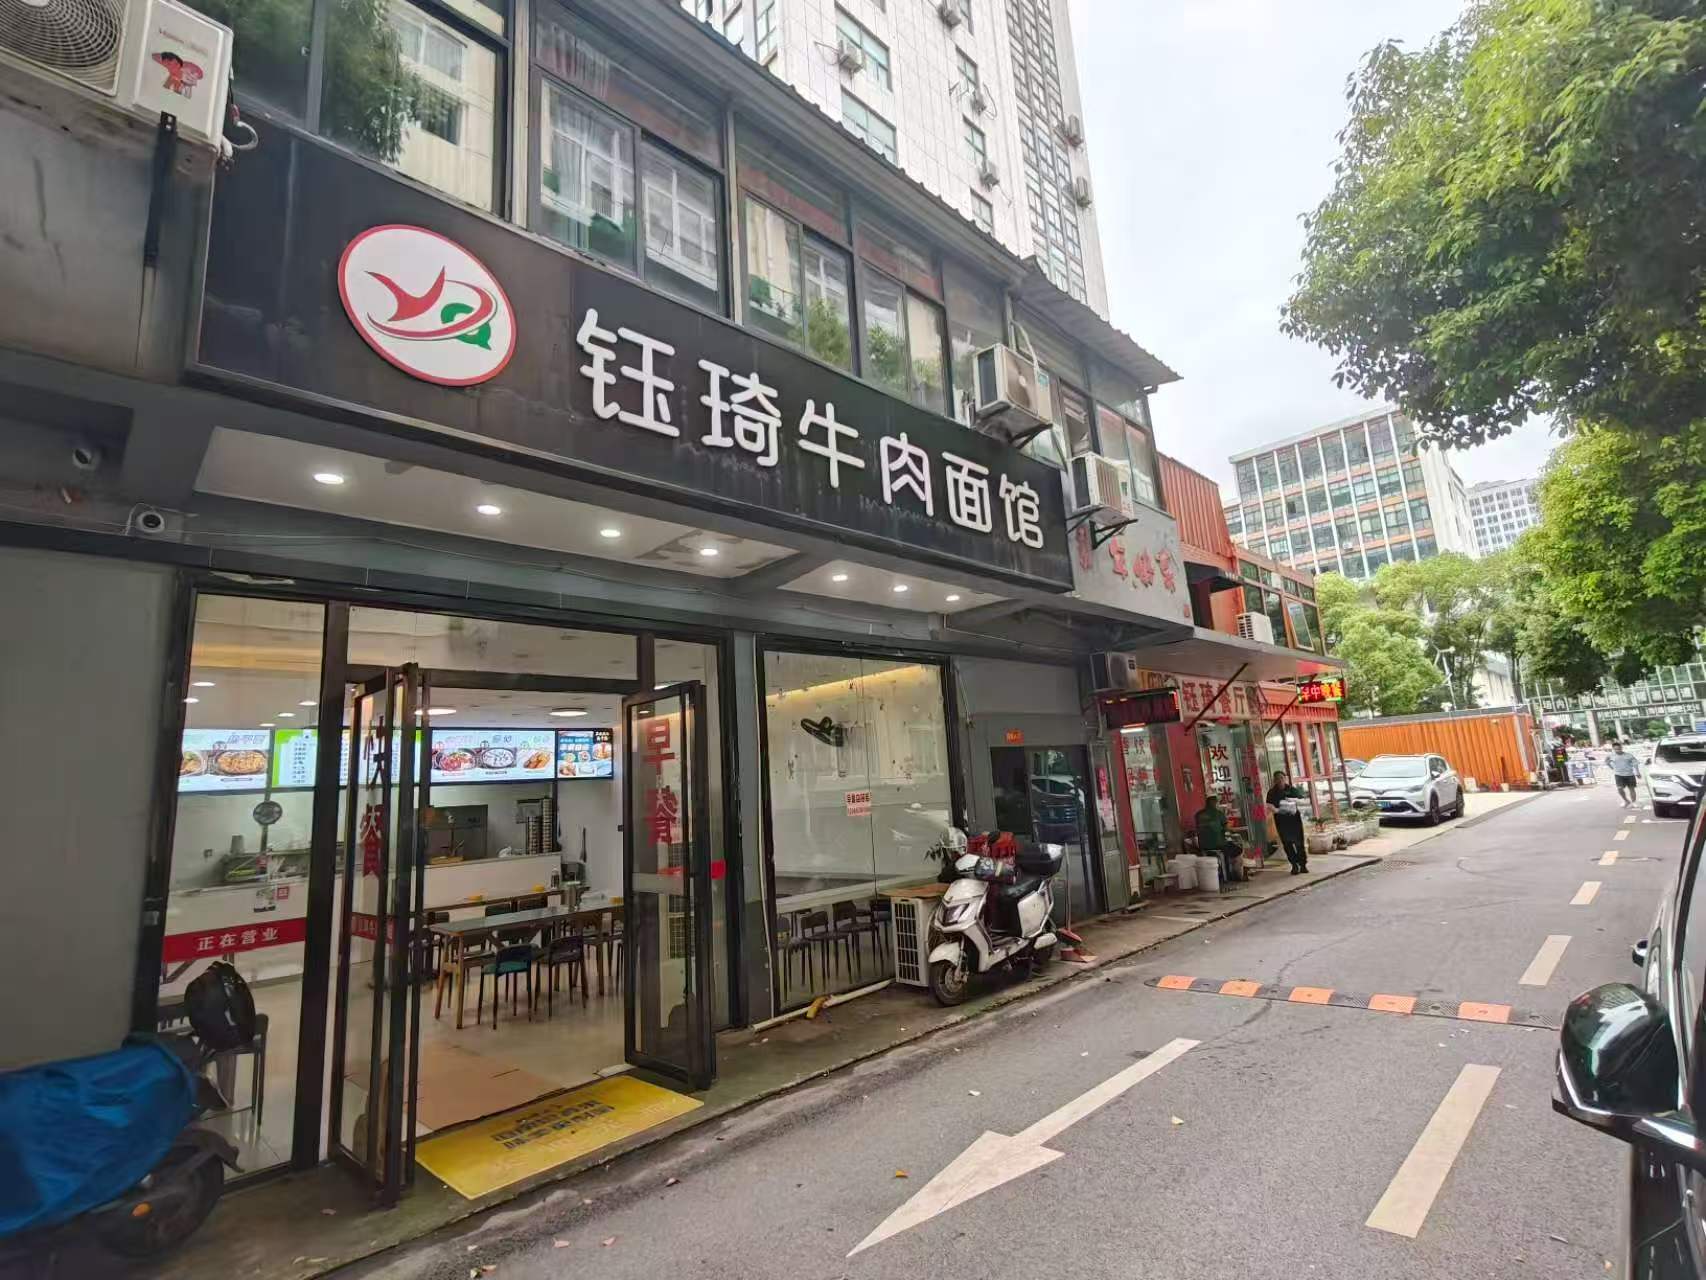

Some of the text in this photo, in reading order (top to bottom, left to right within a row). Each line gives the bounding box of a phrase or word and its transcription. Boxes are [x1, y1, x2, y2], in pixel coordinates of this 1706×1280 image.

[576, 308, 1044, 550] 钰琦牛肉面馆
[642, 718, 679, 848] 早餐
[196, 927, 280, 951] 正在营业
